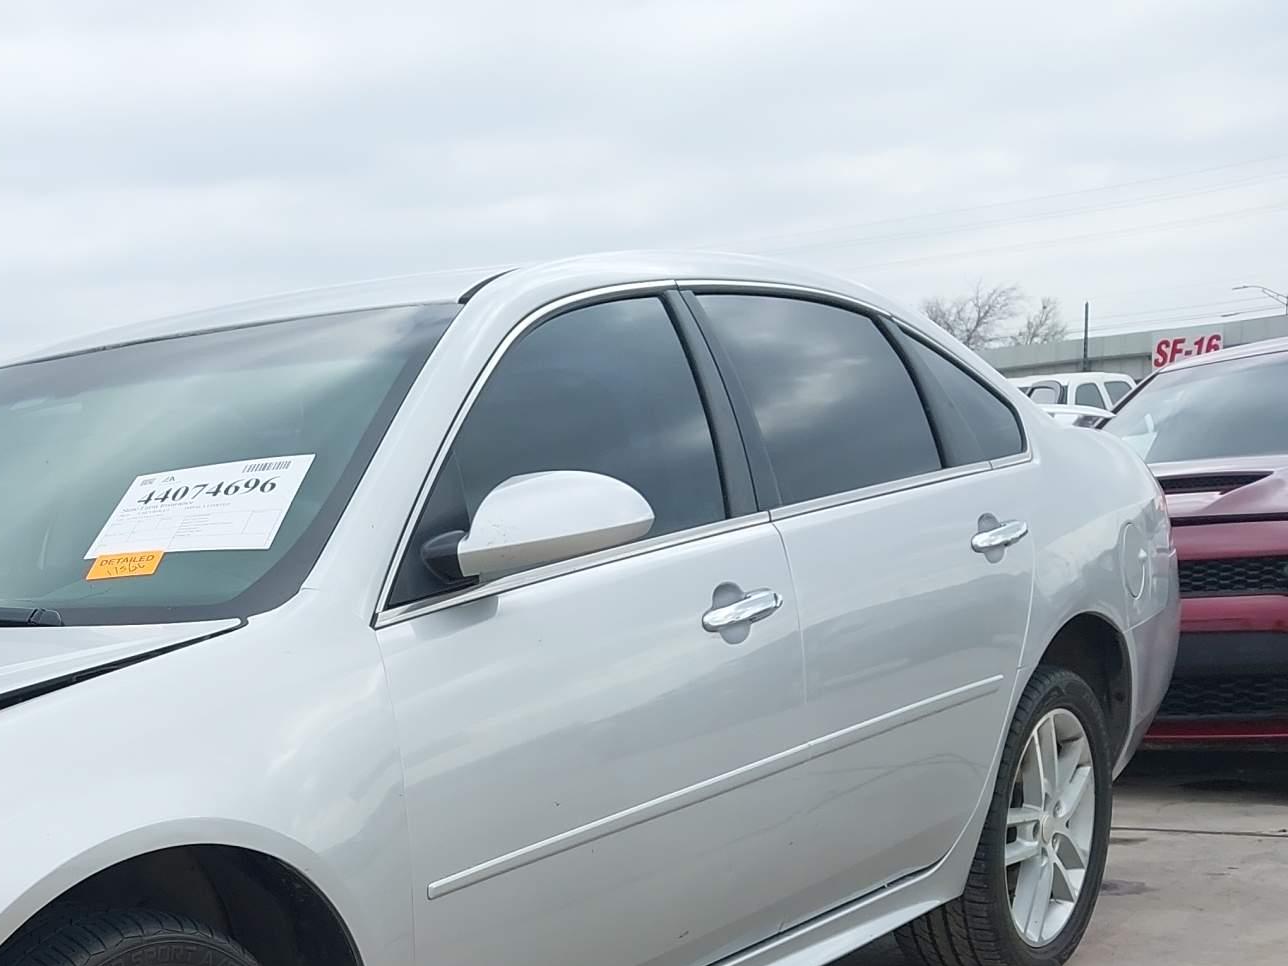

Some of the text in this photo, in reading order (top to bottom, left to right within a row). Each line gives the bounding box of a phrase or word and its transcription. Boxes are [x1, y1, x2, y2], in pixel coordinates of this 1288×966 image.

[1154, 334, 1221, 367] SF-16
[137, 476, 280, 504] 44074696
[100, 554, 154, 567] DETAILED
